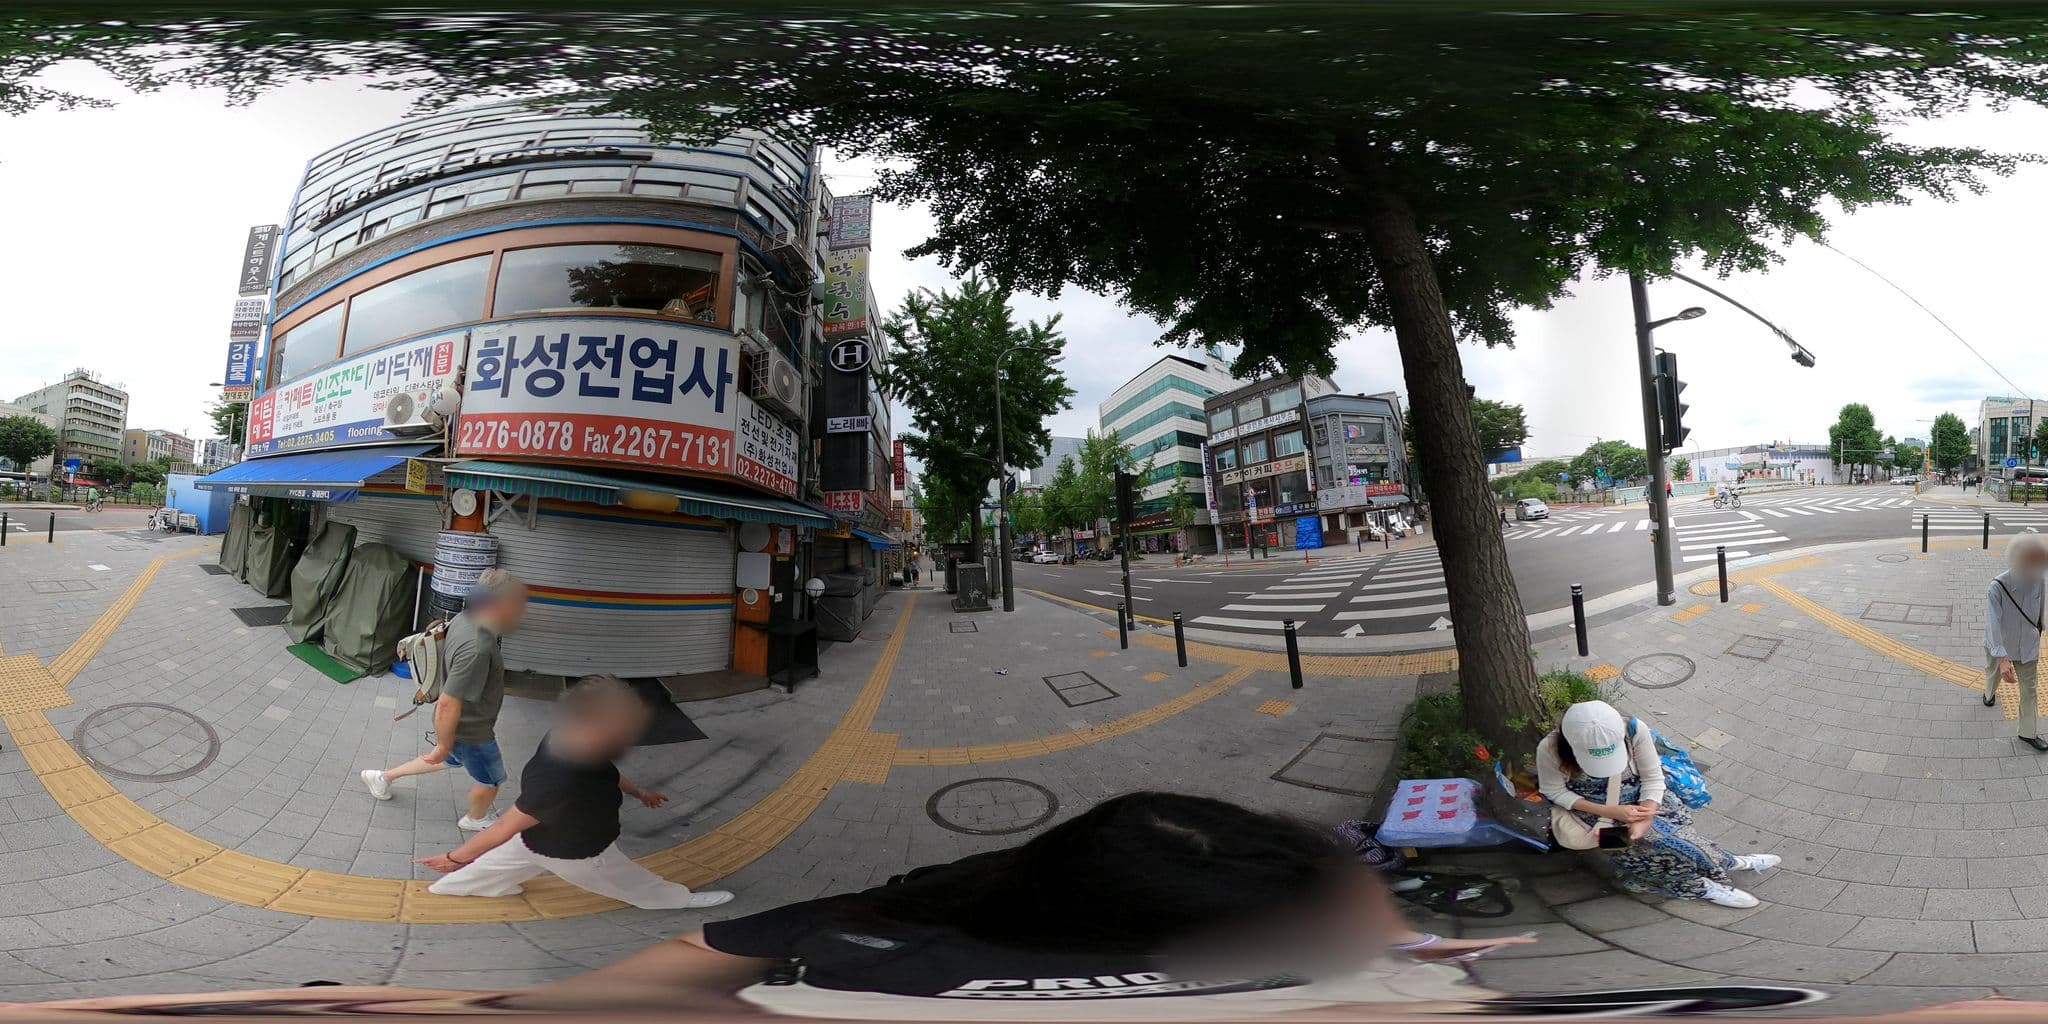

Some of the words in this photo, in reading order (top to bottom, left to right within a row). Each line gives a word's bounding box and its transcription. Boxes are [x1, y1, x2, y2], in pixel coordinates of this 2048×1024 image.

[827, 262, 854, 319] 막국수
[436, 344, 450, 374] 전문
[837, 346, 864, 366] H
[470, 332, 733, 414] 화성전업사
[347, 424, 383, 438] flooring
[829, 417, 870, 431] 노래빠
[460, 420, 574, 451] 2276-0878
[583, 426, 609, 455] Fax
[612, 424, 730, 468] 2267-7131
[824, 492, 861, 510] 대도조명
[955, 971, 1170, 991] PRID
